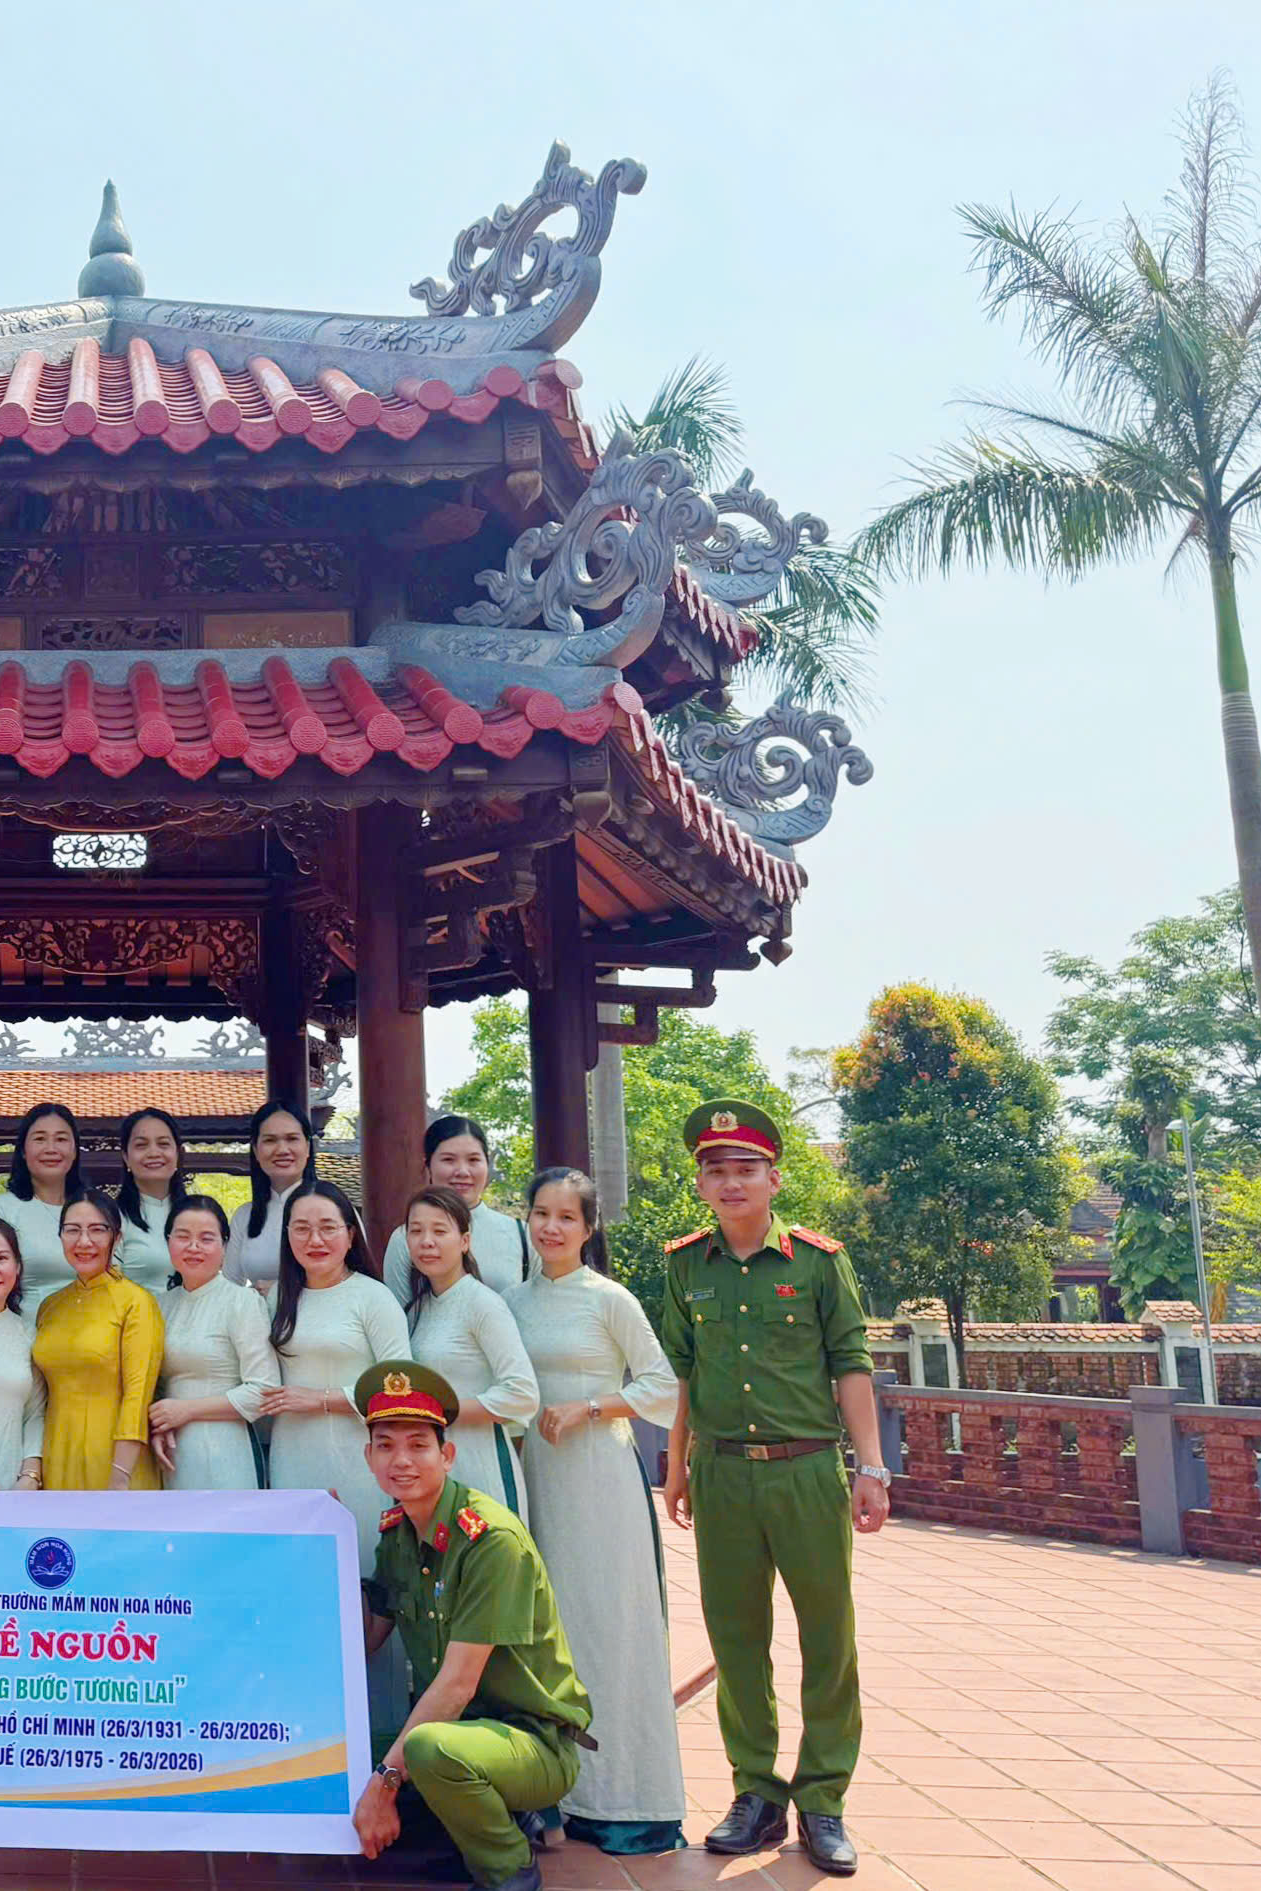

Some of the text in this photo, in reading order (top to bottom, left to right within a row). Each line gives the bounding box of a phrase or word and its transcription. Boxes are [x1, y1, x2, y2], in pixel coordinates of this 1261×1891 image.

[90, 1597, 119, 1613] NON
[123, 1598, 150, 1614] HOA
[30, 1620, 157, 1661] NGUỒN
[16, 1674, 68, 1700] BƯỚC
[74, 1679, 138, 1702] TƯƠNG
[22, 1714, 48, 1735] CHÍ
[53, 1718, 95, 1736] MINH
[101, 1719, 182, 1739] (26/3/1931
[200, 1722, 290, 1742] 26/3/2026);
[20, 1748, 103, 1768] (26/3/1975
[119, 1752, 203, 1772] 26/3/2026)
